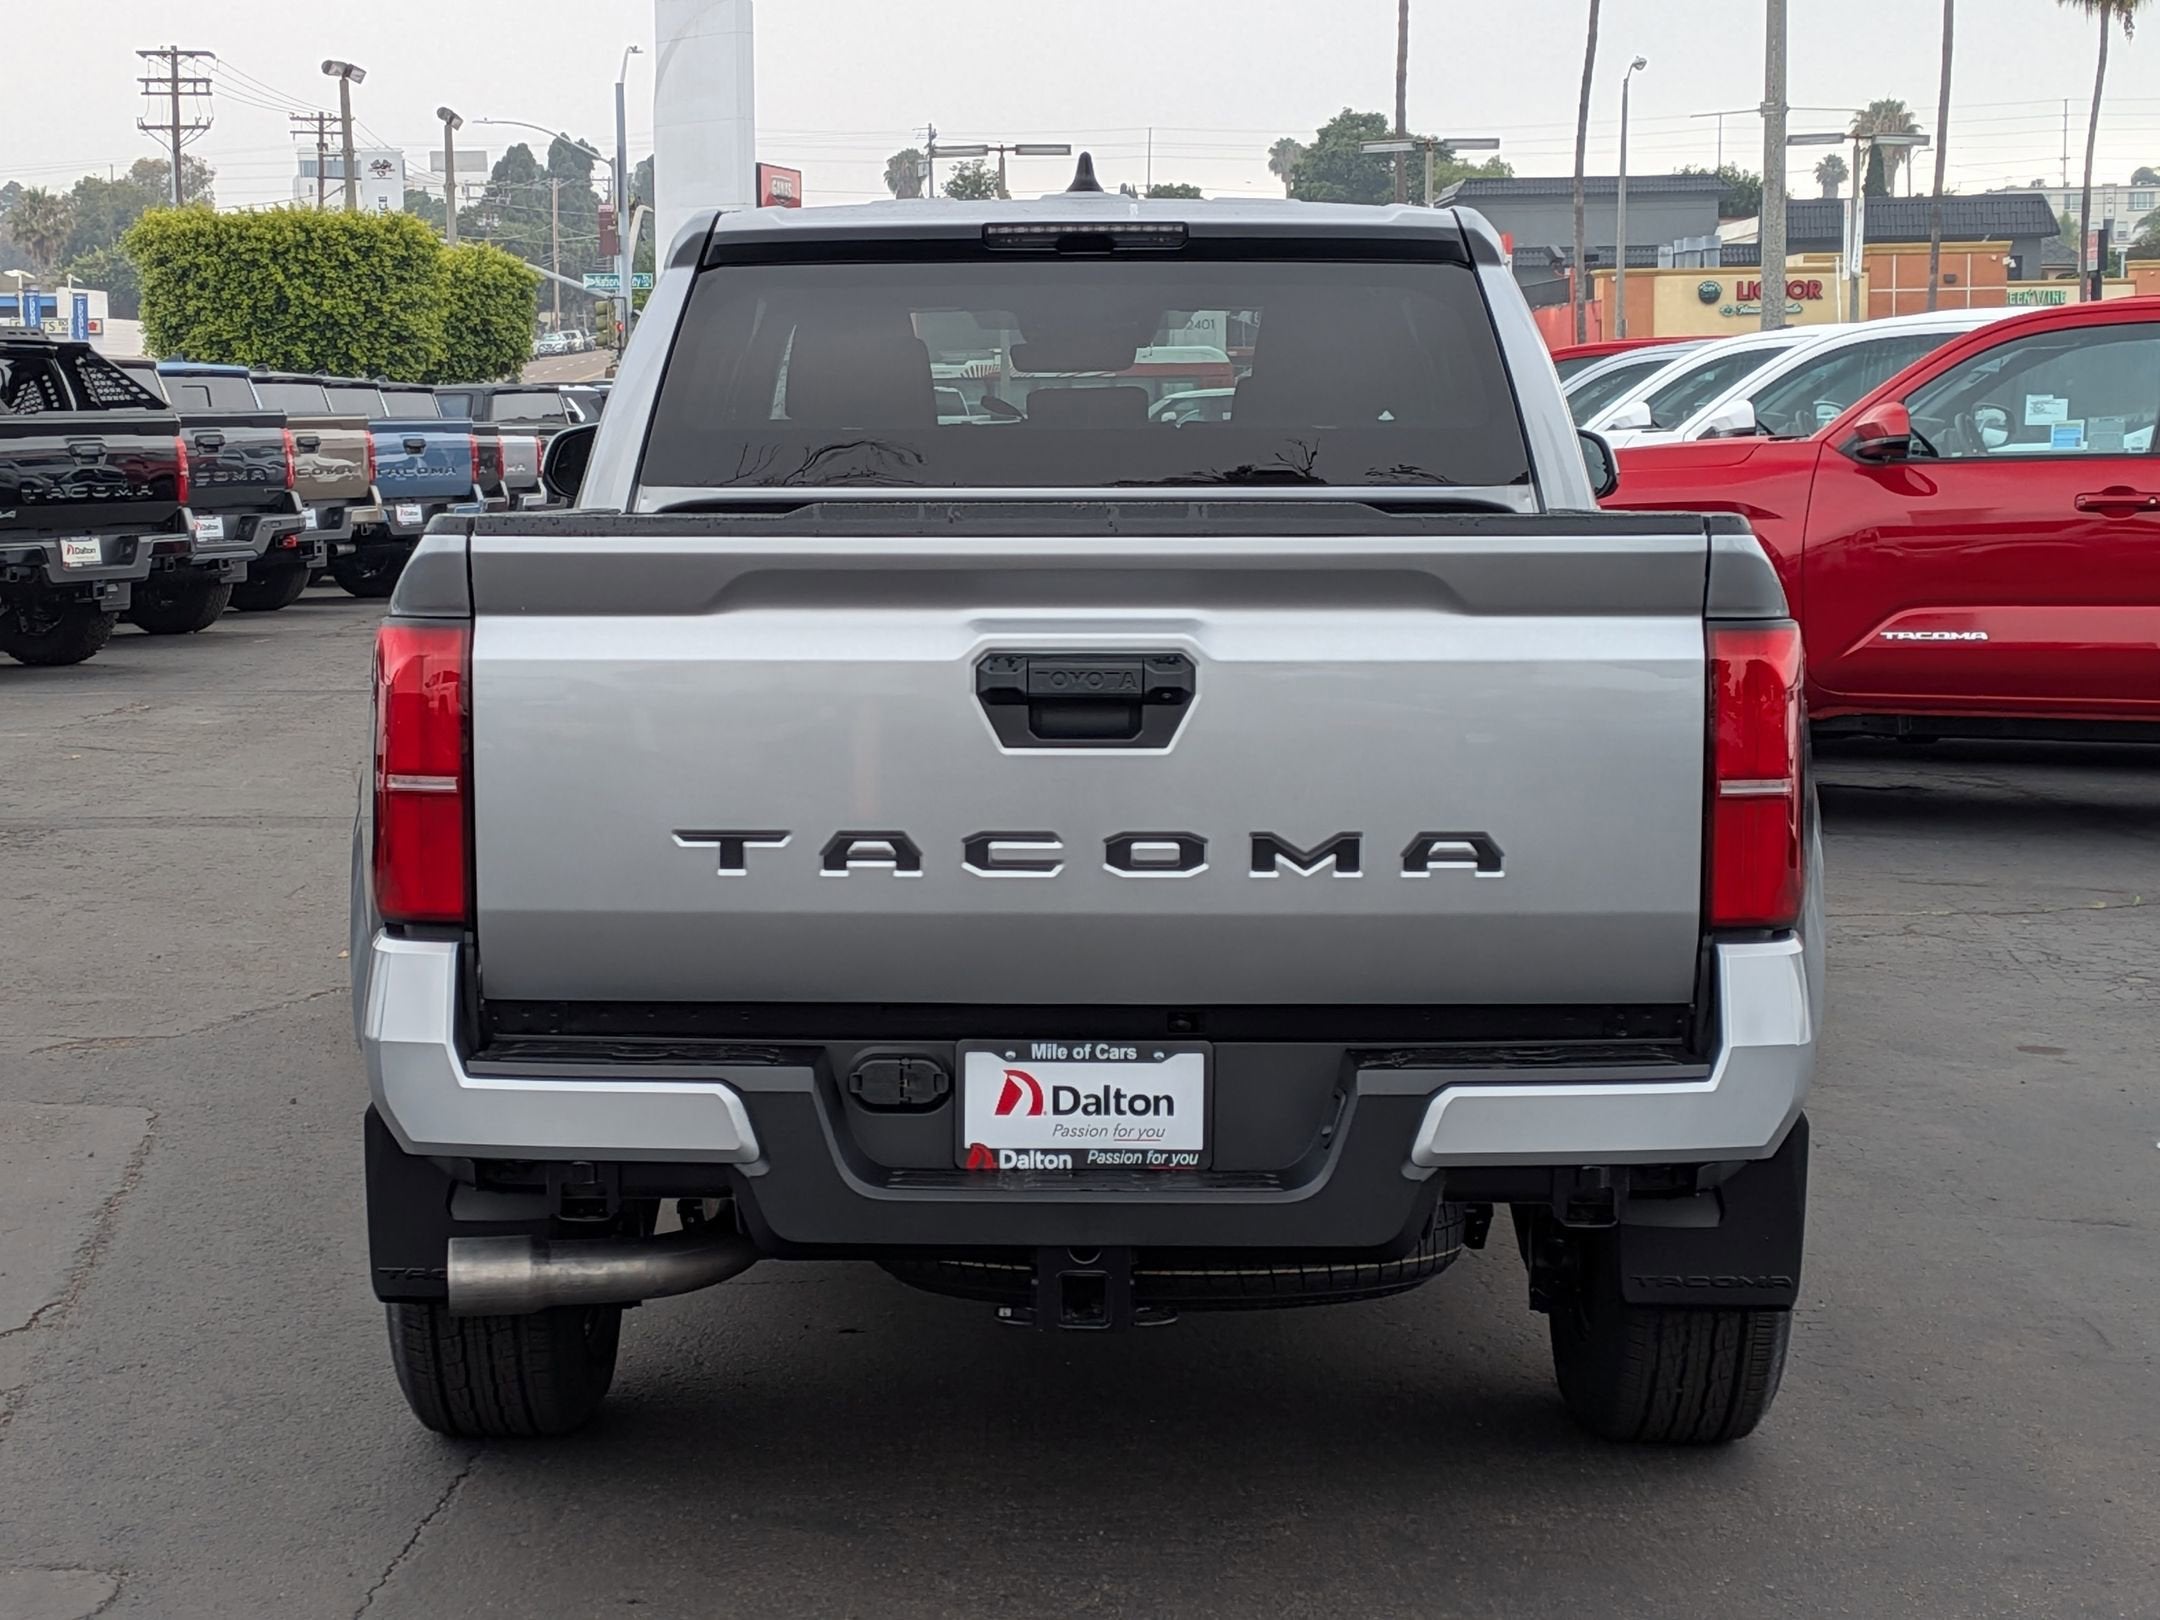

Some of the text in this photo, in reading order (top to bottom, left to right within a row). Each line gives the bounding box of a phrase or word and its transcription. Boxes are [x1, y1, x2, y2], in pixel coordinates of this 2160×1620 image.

[1736, 280, 1823, 301] LIOR
[1185, 319, 1215, 330] 2401
[195, 470, 266, 482] COMA
[21, 485, 153, 499] TACOMA
[75, 546, 96, 555] Dalton
[1880, 632, 1988, 640] TACOMA
[1034, 671, 1137, 690] TOYOTA
[671, 829, 1507, 878] TACOMA
[1031, 1044, 1137, 1060] Mile of Cars
[1052, 1085, 1174, 1117] Dalton
[1052, 1123, 1165, 1140] Passion for you
[1000, 1150, 1199, 1170] Dalton Passion for you
[1629, 1275, 1793, 1288] TACOMA
